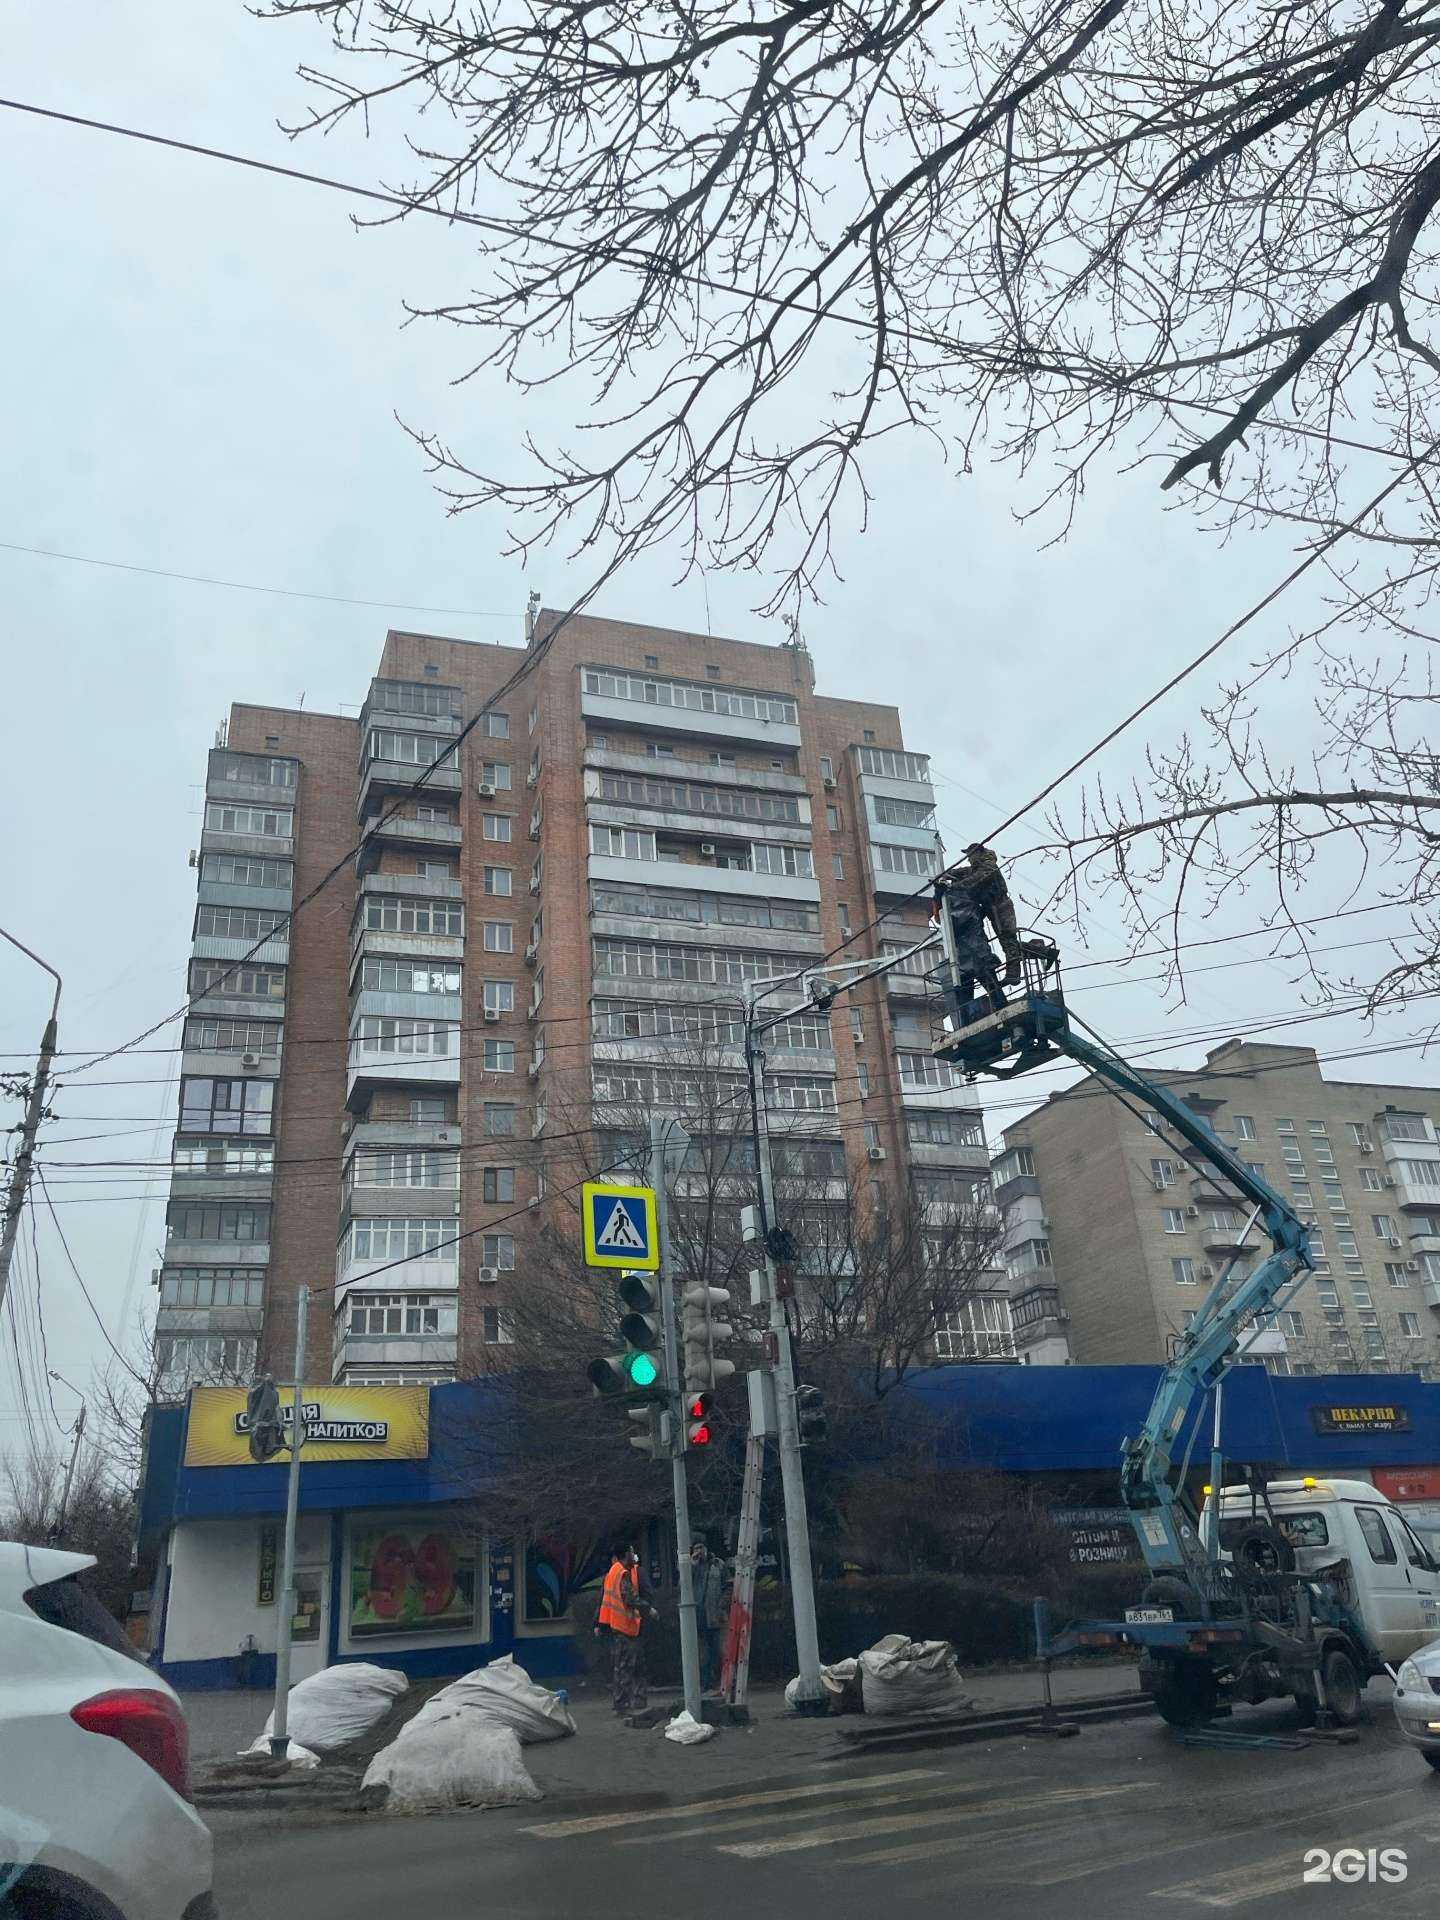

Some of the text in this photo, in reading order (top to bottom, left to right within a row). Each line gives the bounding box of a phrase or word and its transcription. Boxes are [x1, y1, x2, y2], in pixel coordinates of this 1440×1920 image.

[1331, 1408, 1395, 1421] ПЕКАРНЯ
[307, 1422, 386, 1438] НАПИТКОВ
[1078, 1546, 1127, 1562] РОЗНИЦУ
